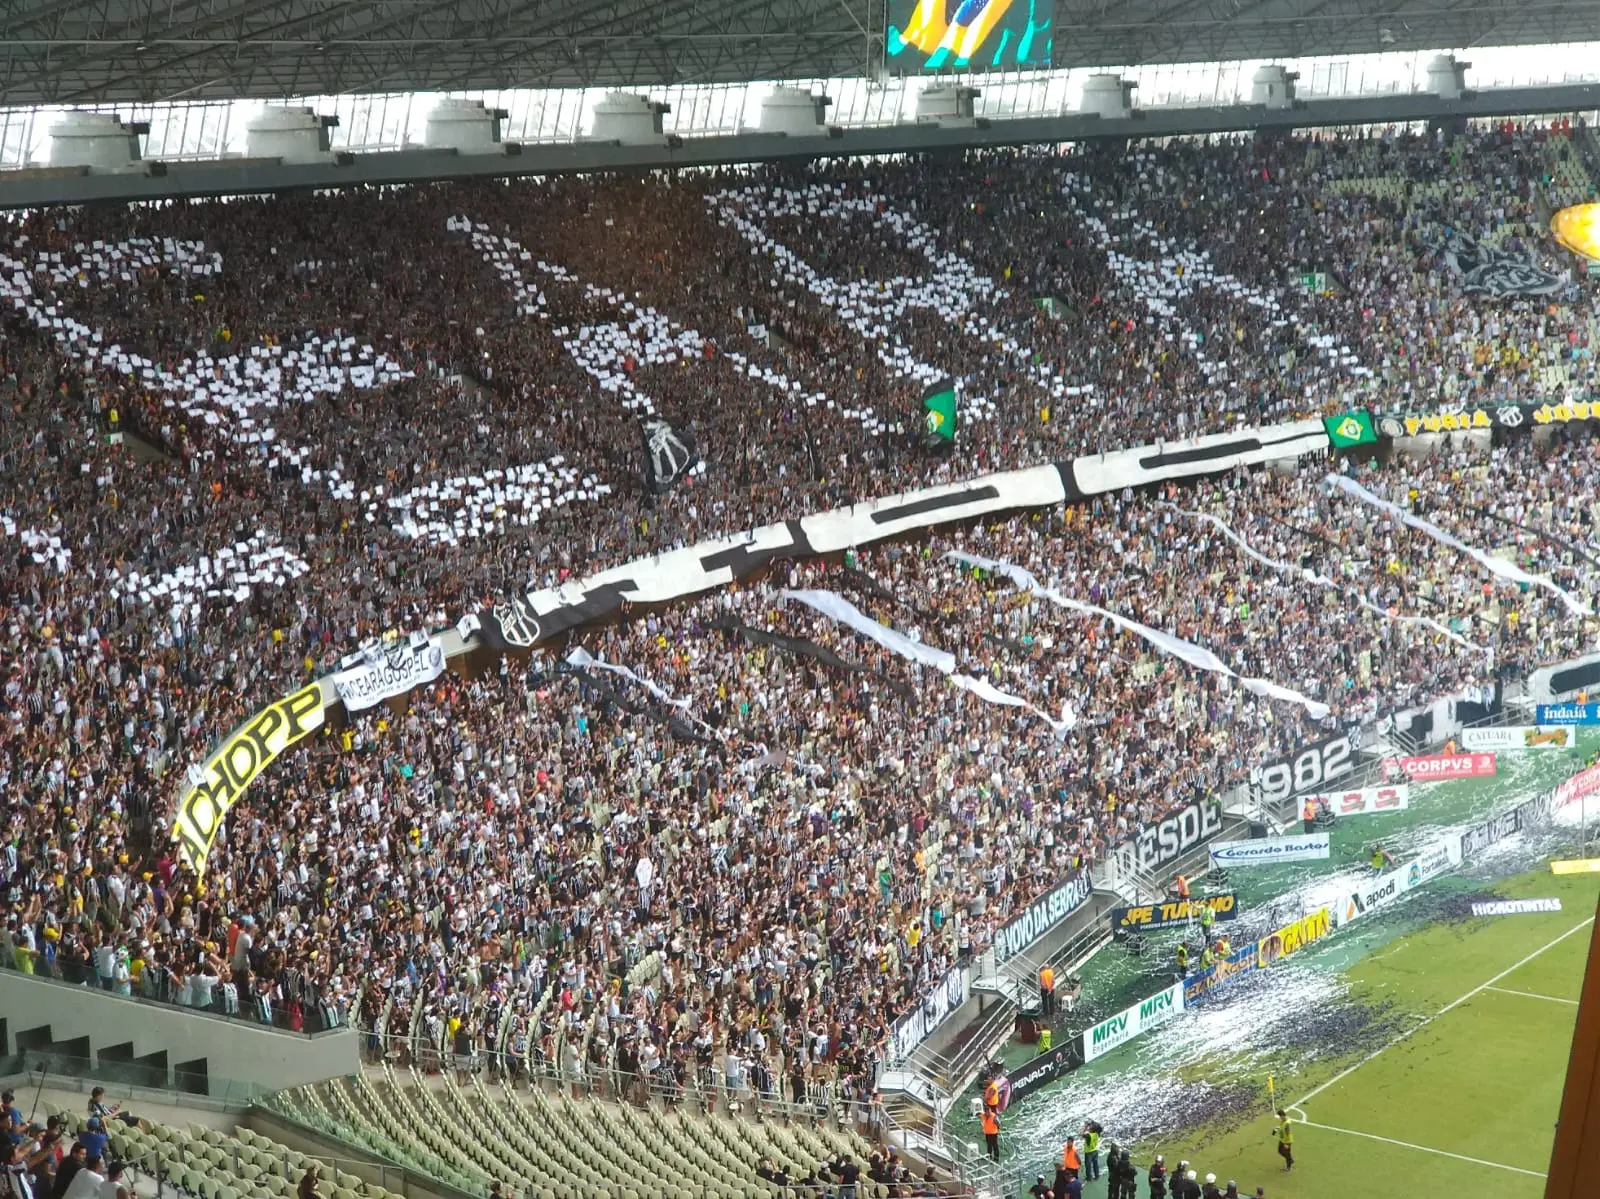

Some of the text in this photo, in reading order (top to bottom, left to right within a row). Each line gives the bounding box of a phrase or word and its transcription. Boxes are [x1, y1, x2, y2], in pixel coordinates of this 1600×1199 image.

[1406, 757, 1472, 773] CORPVS
[1113, 799, 1222, 878] DESDE
[1365, 878, 1395, 907] apodi
[1120, 905, 1153, 926] JPE
[1161, 895, 1234, 920] TURMO
[1140, 988, 1174, 1020] MRV
[1093, 1011, 1128, 1045] MRV
